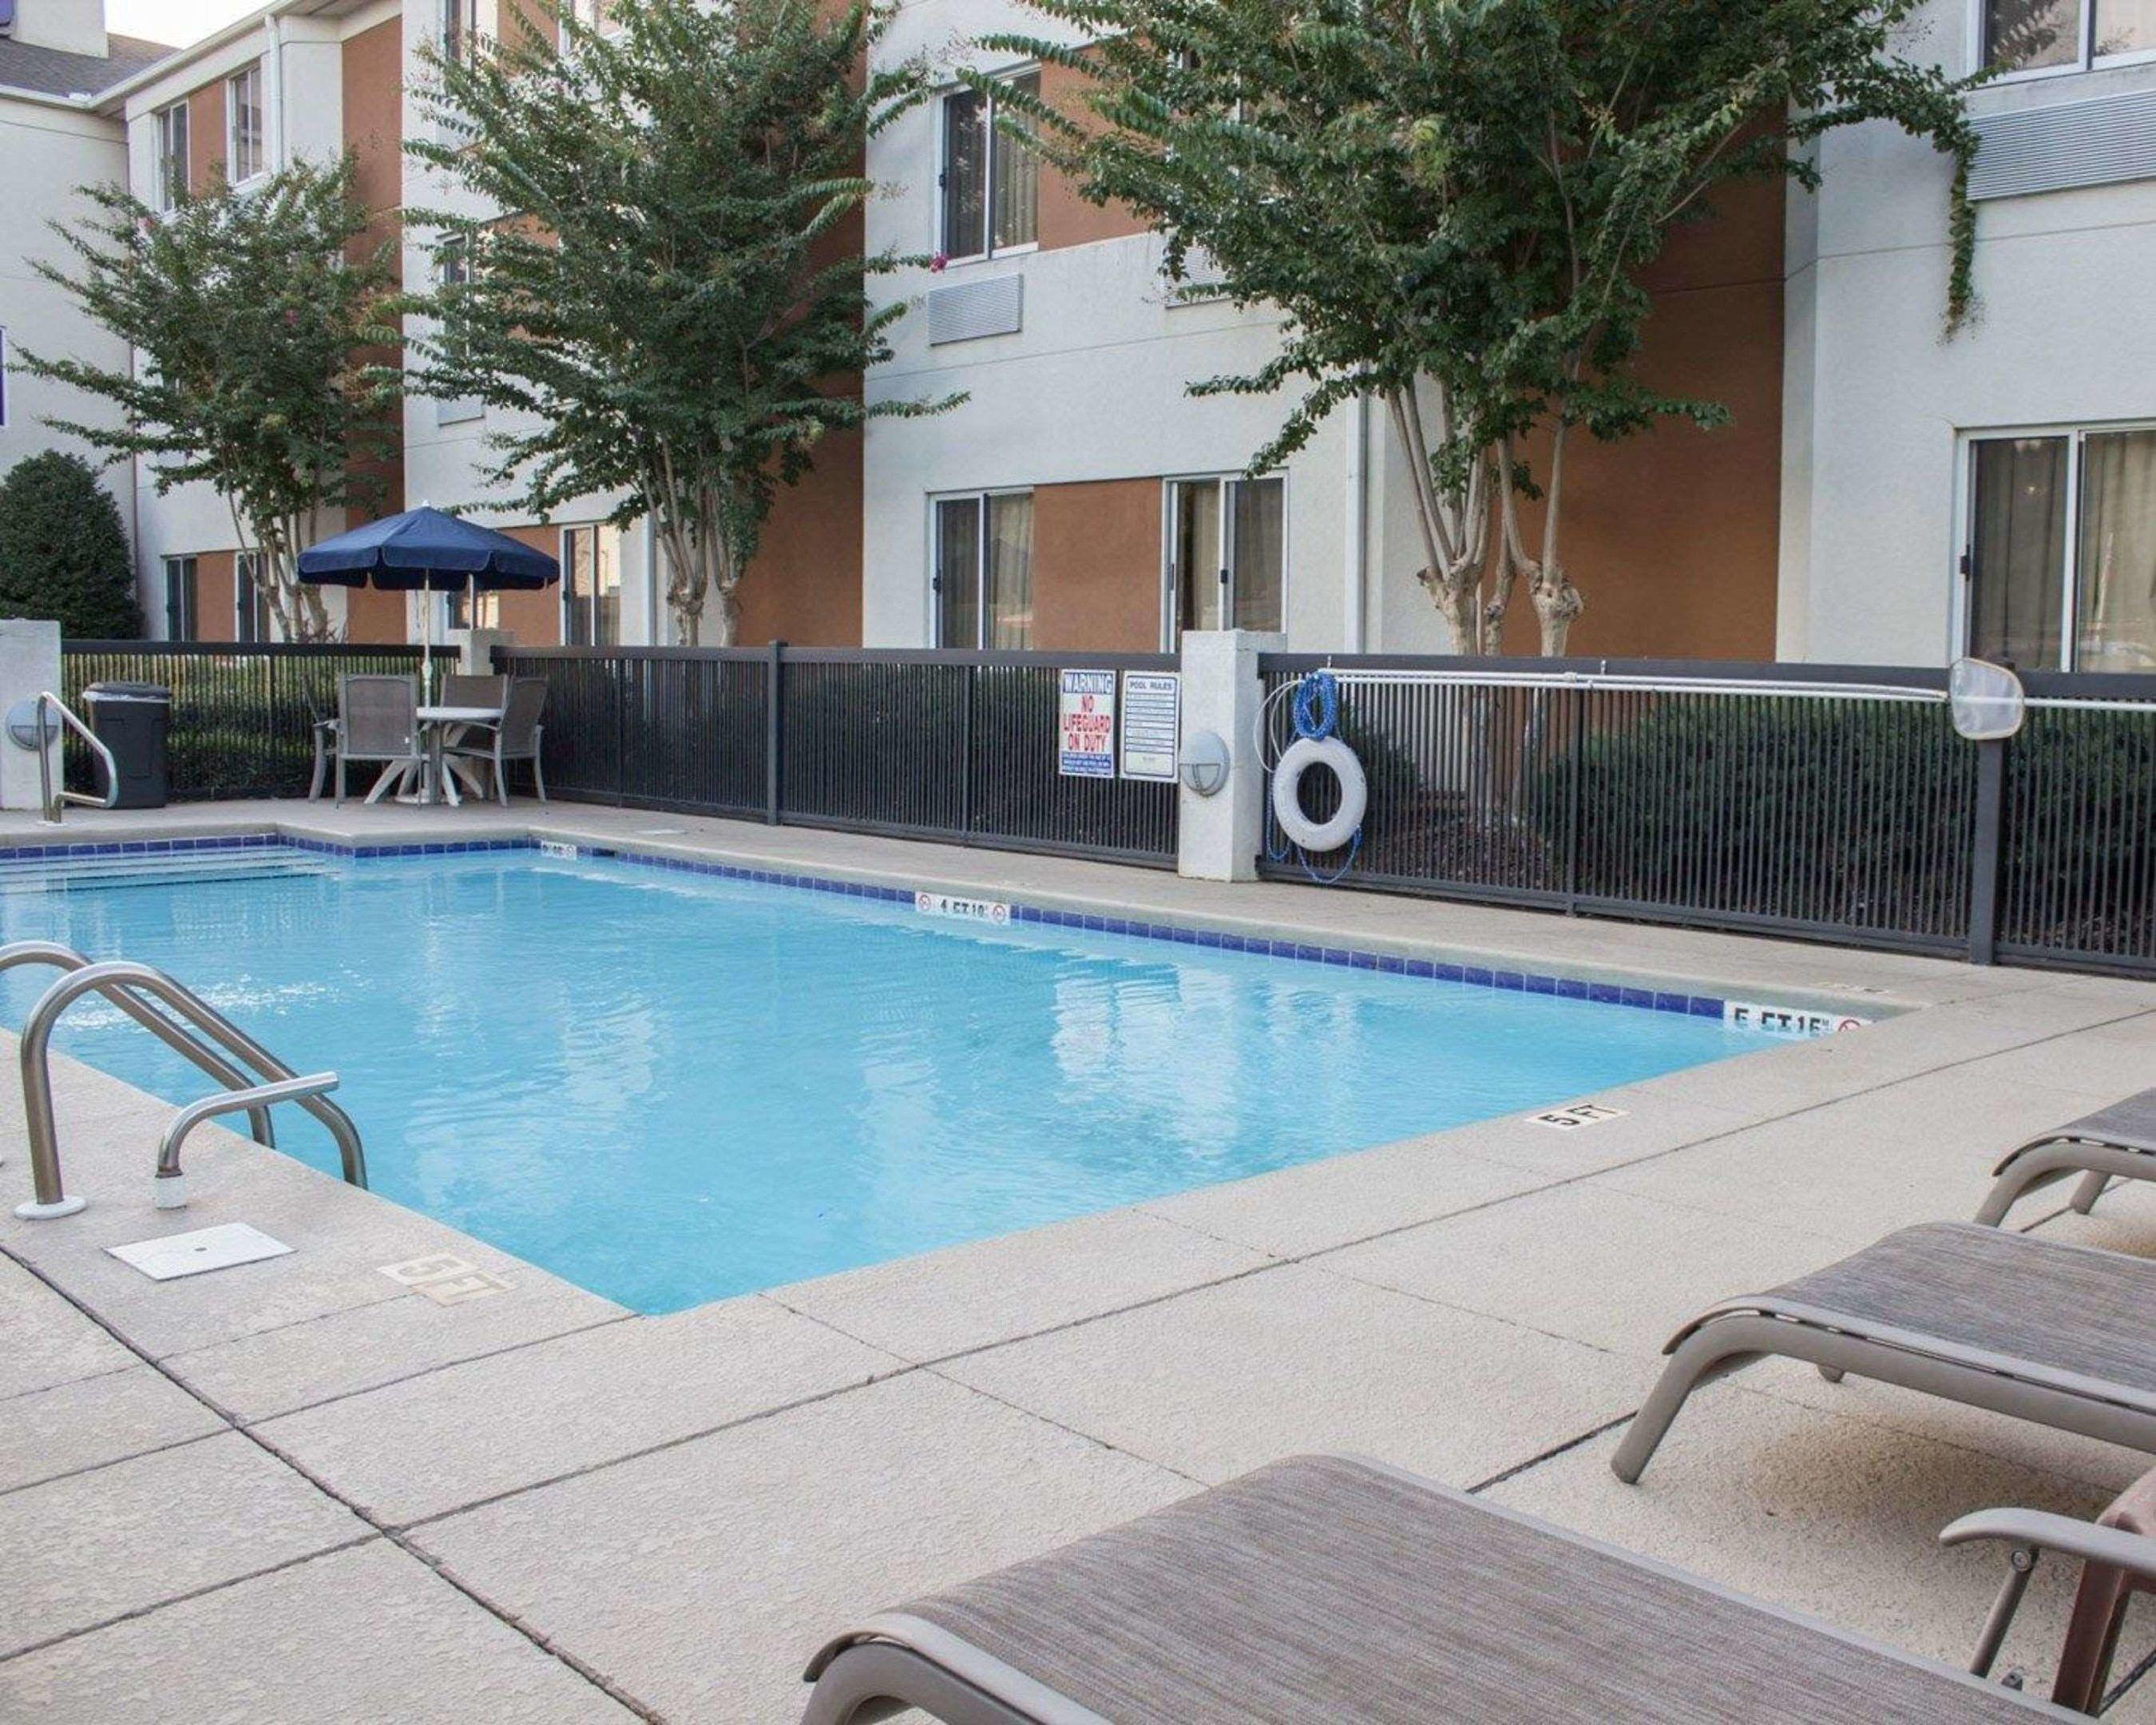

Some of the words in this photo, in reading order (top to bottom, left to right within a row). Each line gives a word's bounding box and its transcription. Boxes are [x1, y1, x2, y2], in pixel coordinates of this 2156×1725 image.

[1064, 673, 1113, 693] WARNING
[1129, 680, 1147, 690] POOL
[1150, 681, 1172, 691] RULES
[1081, 695, 1095, 712] NO
[1064, 713, 1111, 733] LIFEGUARD
[1068, 733, 1080, 751] ON
[1084, 734, 1106, 752] DUTY
[1538, 1114, 1580, 1126] 5
[1565, 1104, 1617, 1119] FT
